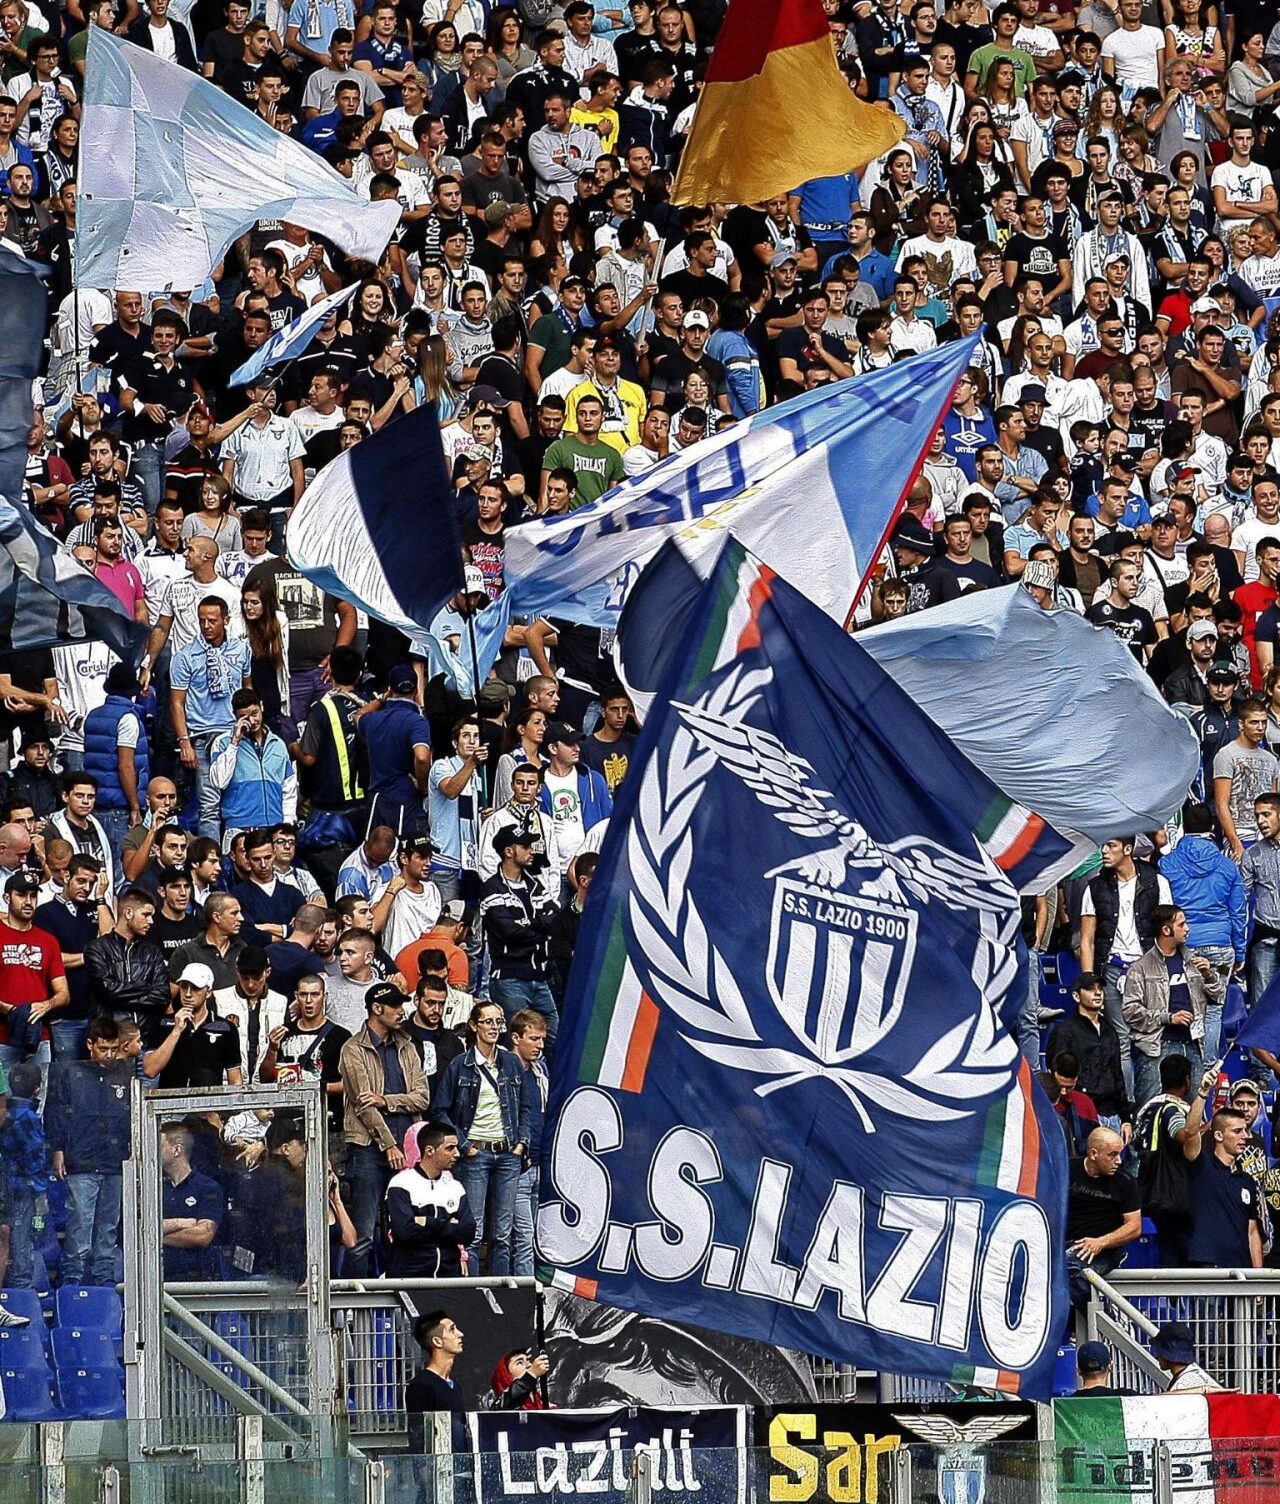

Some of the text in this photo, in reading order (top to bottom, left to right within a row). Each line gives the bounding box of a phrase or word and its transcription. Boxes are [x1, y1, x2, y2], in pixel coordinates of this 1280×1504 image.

[573, 453, 607, 477] EVERLAST
[955, 446, 978, 454] umbr
[783, 892, 906, 936] S.S. LAZIO 1900
[536, 1086, 1052, 1370] S.S.LAZIO
